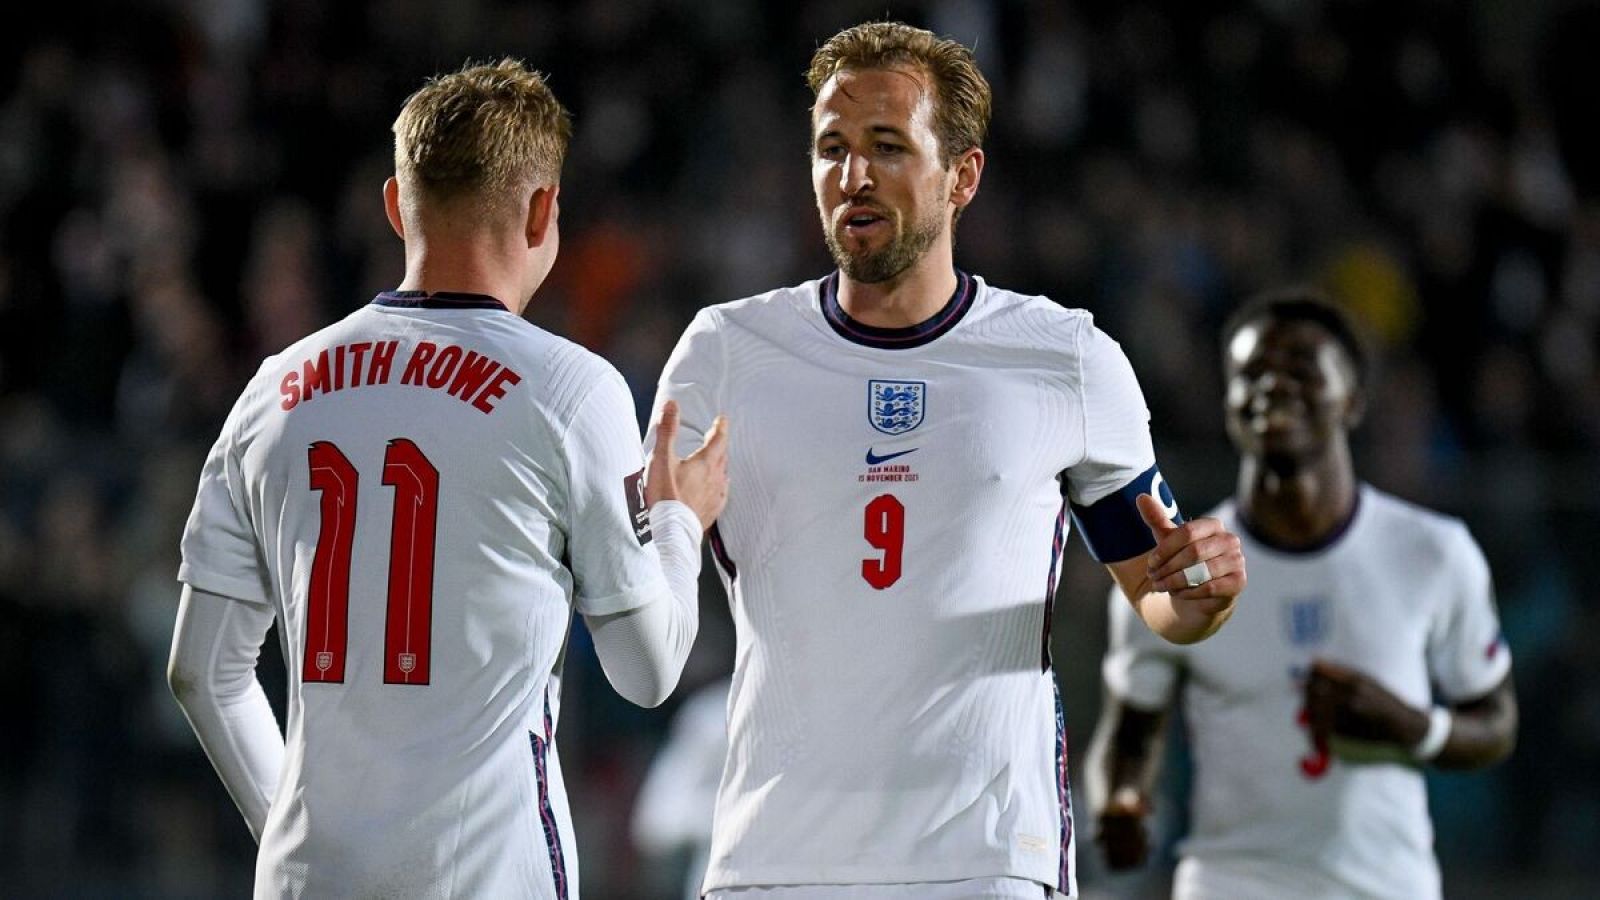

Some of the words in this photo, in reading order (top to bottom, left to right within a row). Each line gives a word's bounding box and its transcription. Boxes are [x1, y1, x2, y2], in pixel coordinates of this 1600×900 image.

[280, 341, 399, 411] SMITH
[400, 341, 521, 414] ROWE
[866, 474, 903, 482] NOVEMBER
[883, 464, 910, 473] MARINO
[302, 438, 440, 686] 11
[861, 493, 905, 590] 9
